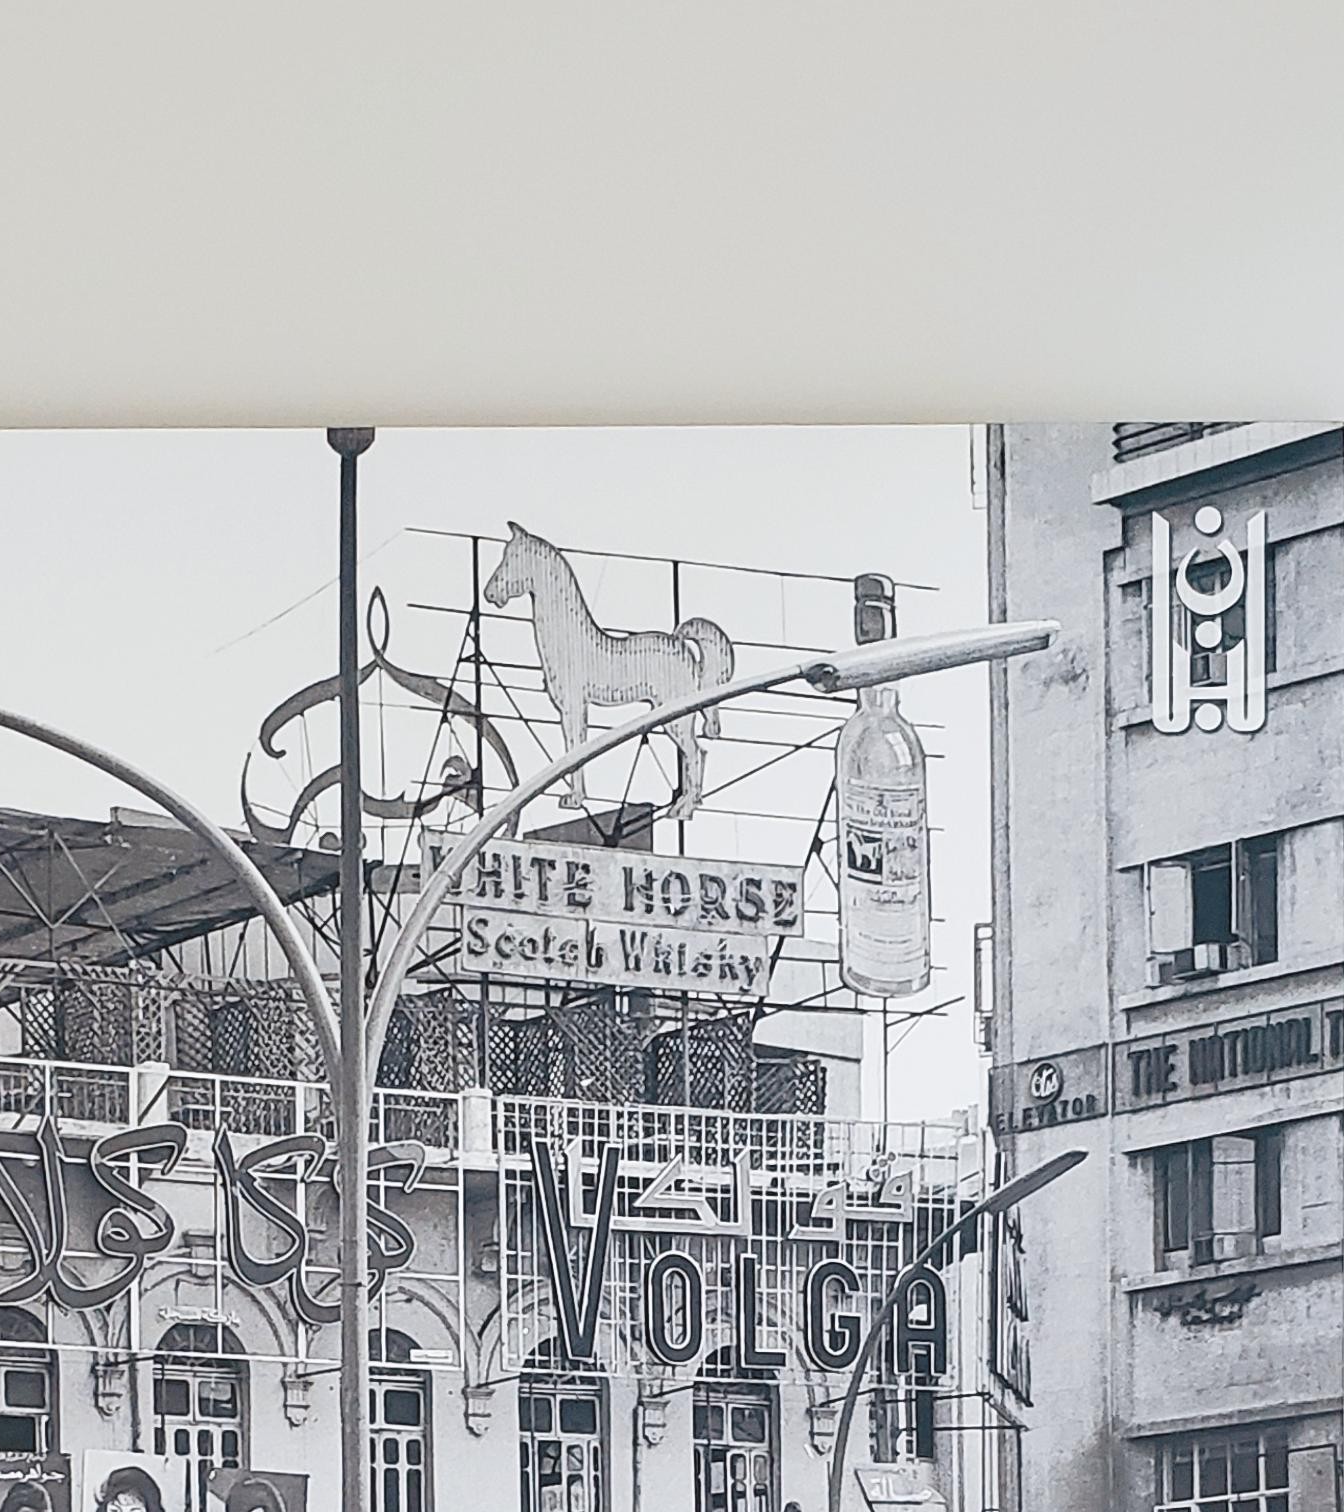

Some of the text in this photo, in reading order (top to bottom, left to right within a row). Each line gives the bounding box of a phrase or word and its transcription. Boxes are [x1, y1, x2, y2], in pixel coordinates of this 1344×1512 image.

[622, 865, 798, 928] HORSE
[466, 916, 605, 970] Scotch
[1127, 1044, 1178, 1097] THE
[1189, 1017, 1320, 1085] NATIONAL
[994, 1094, 1098, 1132] ELEVATOR
[530, 1140, 948, 1378] VOLGA
